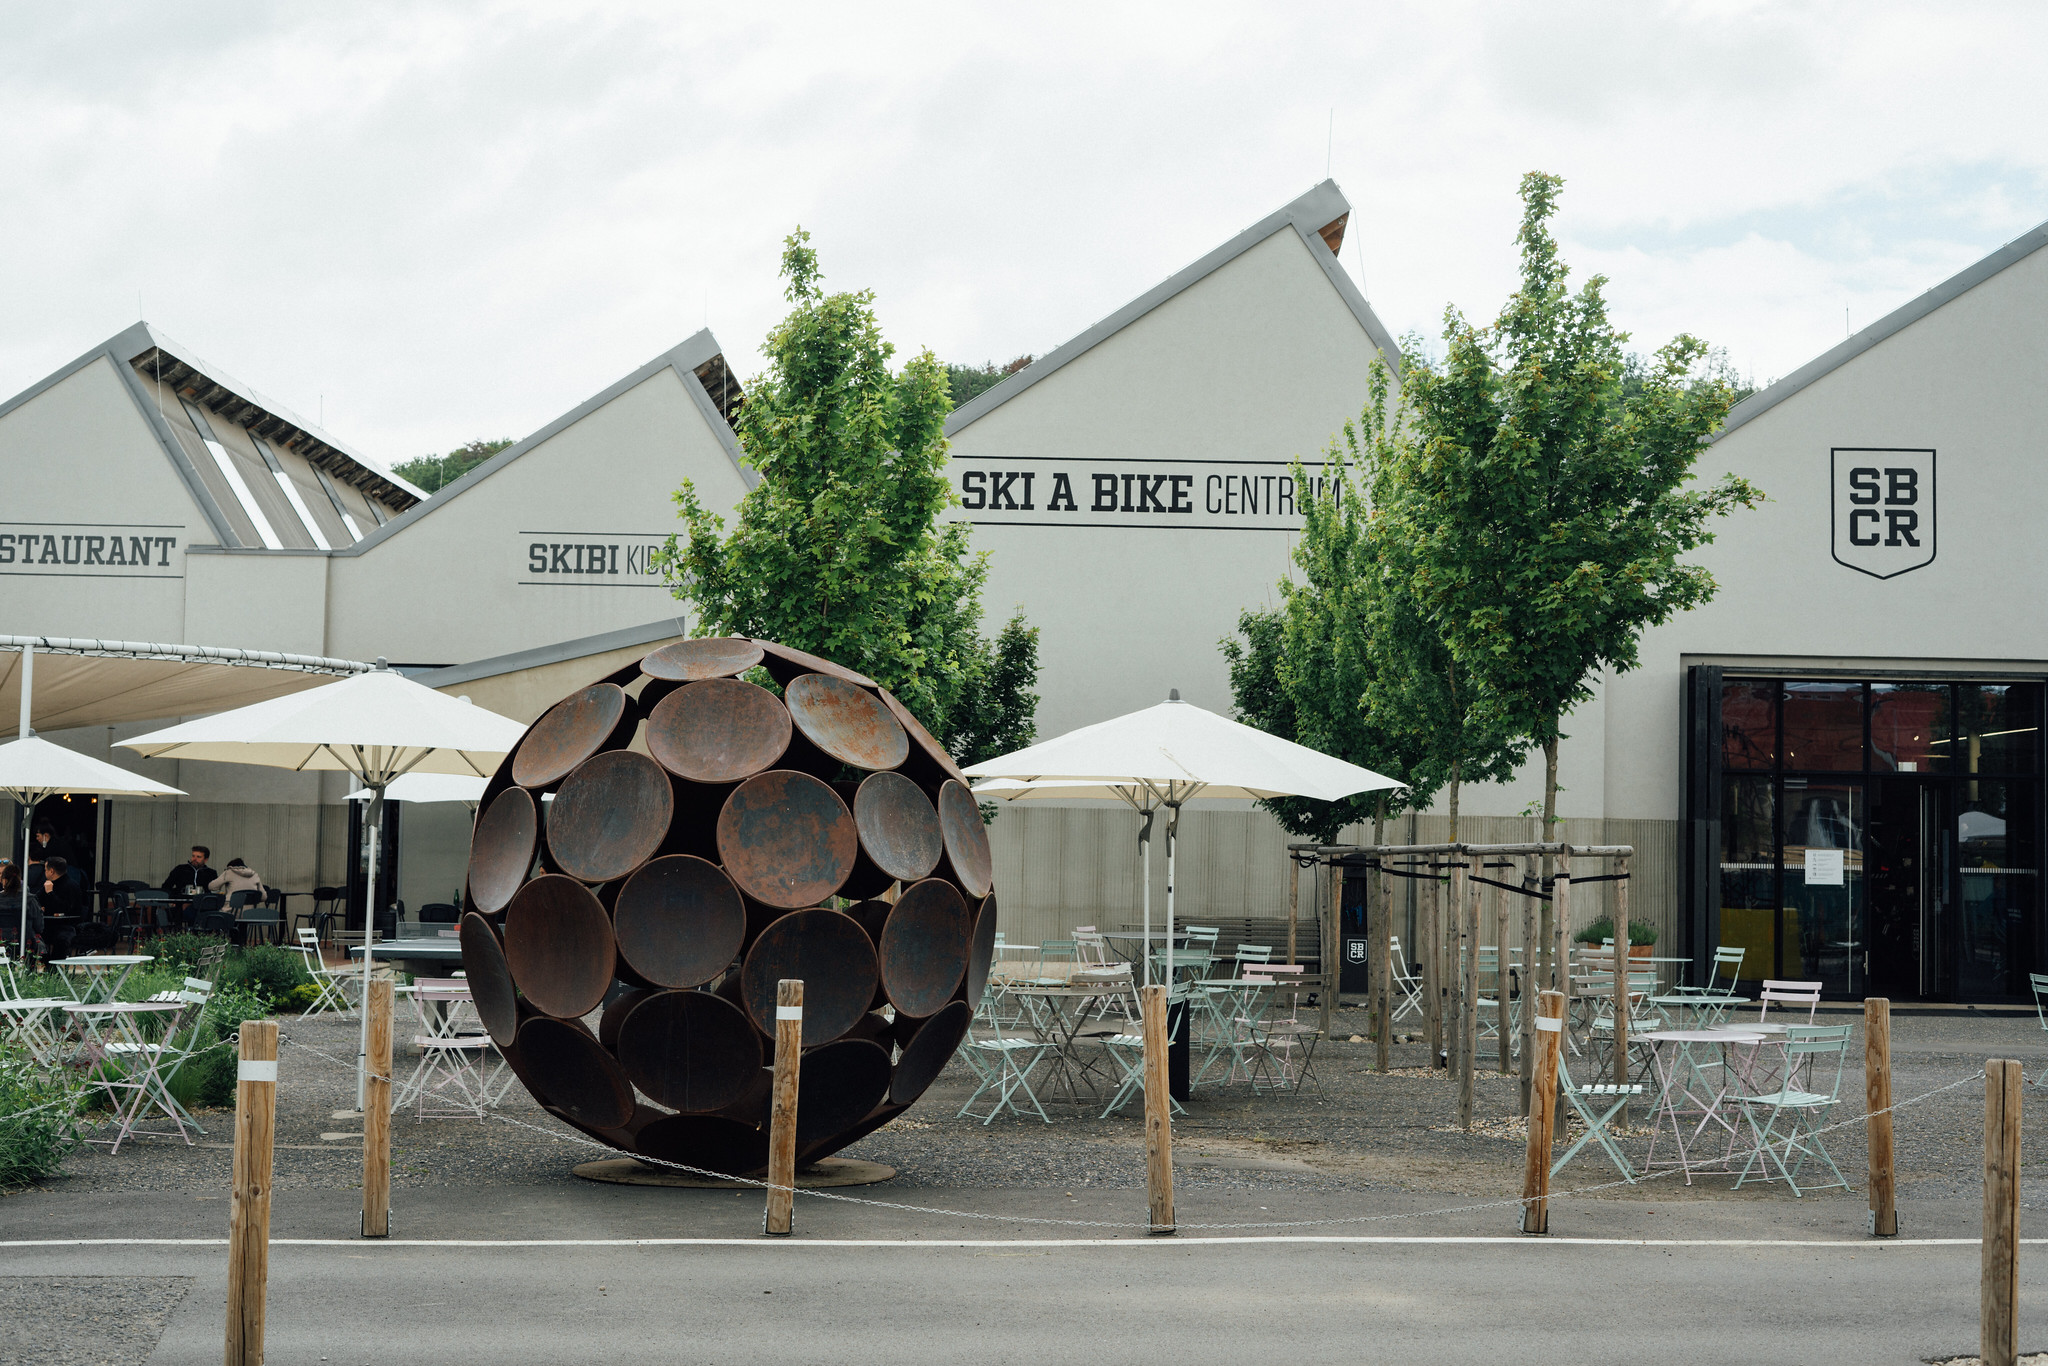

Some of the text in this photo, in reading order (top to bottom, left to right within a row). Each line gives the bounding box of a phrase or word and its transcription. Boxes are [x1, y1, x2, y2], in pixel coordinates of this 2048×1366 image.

[962, 471, 1035, 510] SKI
[1047, 472, 1078, 511] A
[1091, 473, 1193, 513] BIKE
[1849, 467, 1918, 505] SB
[1849, 509, 1920, 547] CR
[0, 534, 176, 566] STAURANT
[528, 543, 619, 574] SKIBI
